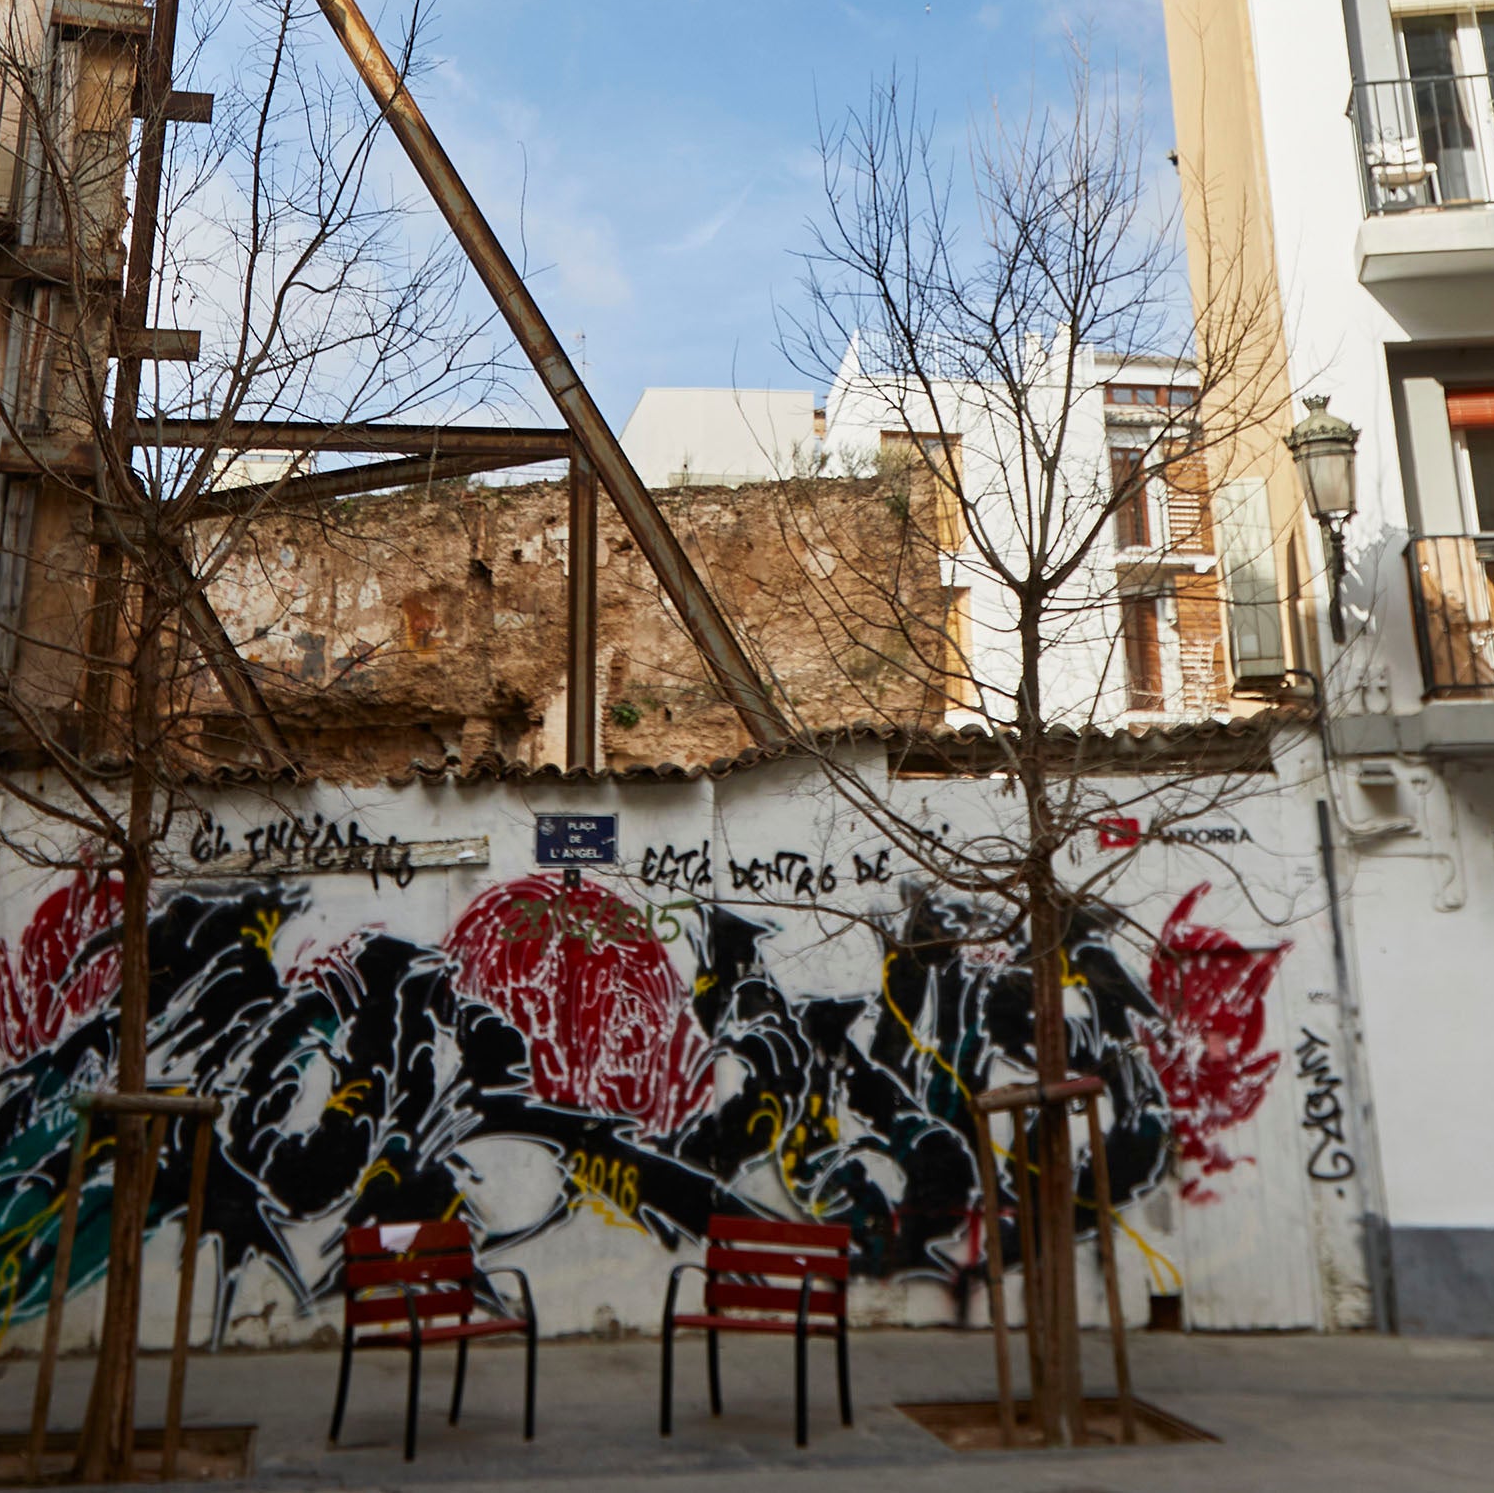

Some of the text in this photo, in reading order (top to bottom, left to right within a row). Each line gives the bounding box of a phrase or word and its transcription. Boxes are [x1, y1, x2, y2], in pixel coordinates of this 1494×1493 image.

[567, 822, 597, 833] PLAÇA
[569, 835, 582, 844] DE
[729, 851, 838, 897] DENTRO
[854, 850, 893, 885] DE
[571, 1150, 639, 1218] 2018
